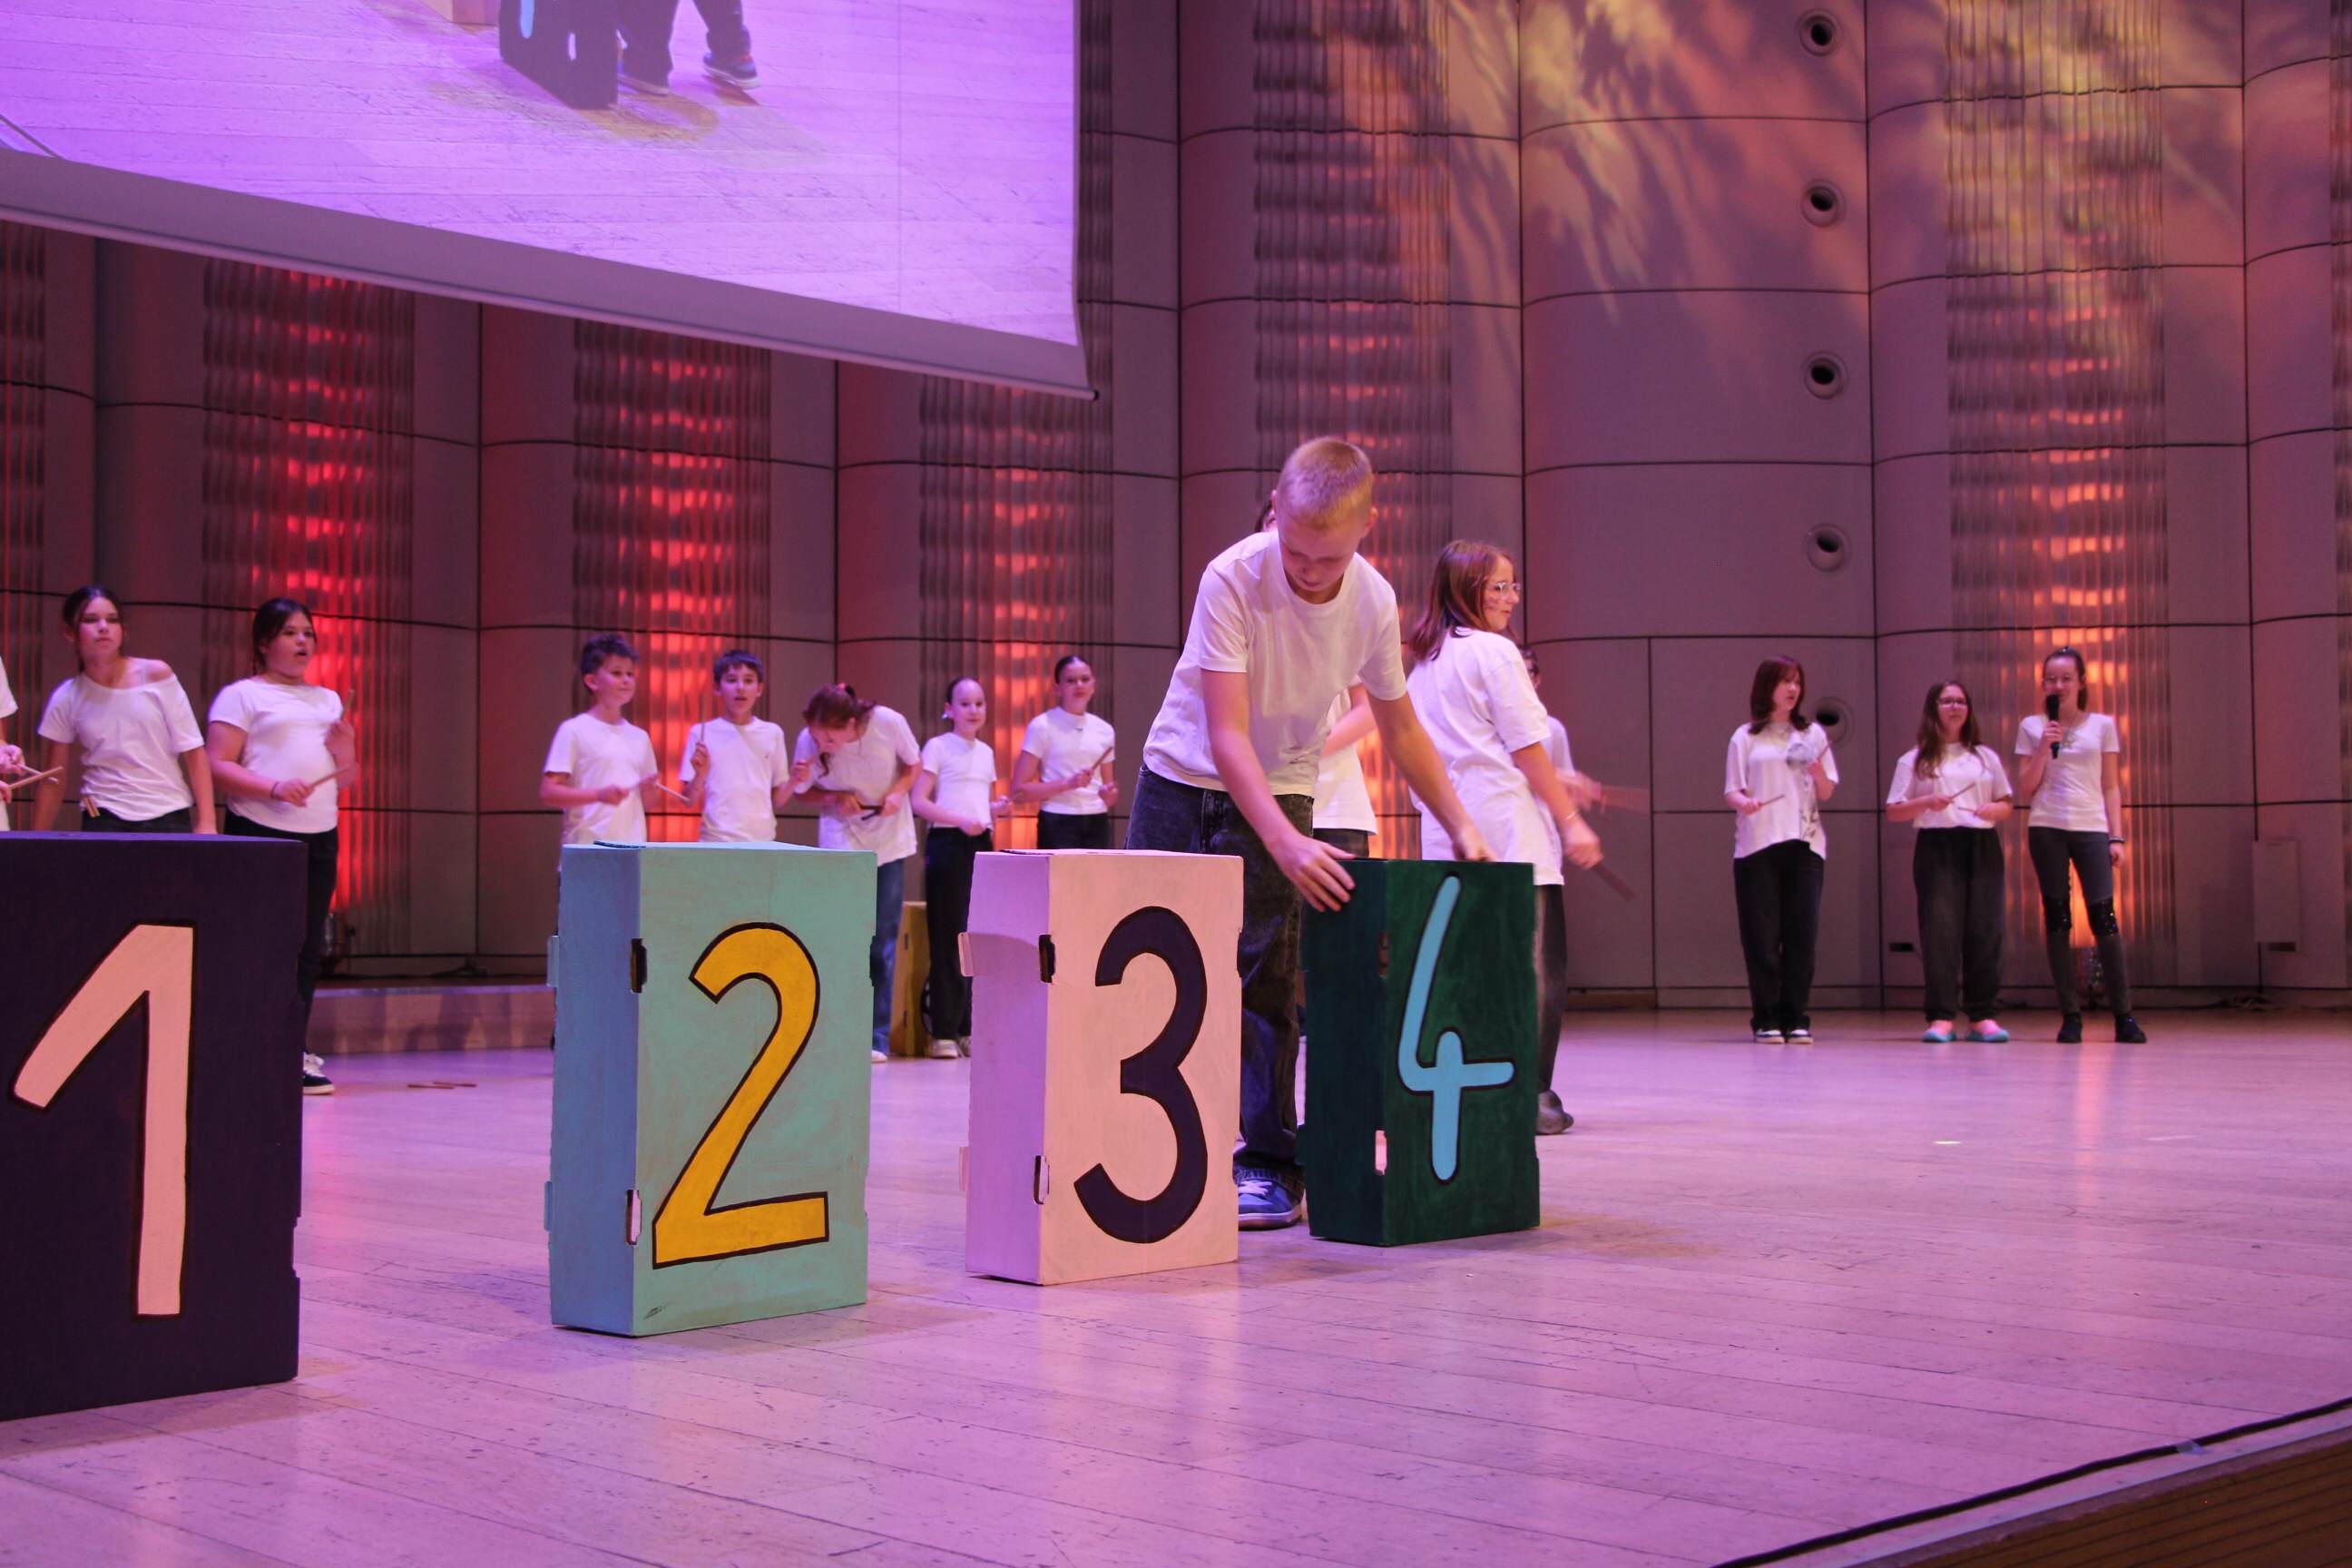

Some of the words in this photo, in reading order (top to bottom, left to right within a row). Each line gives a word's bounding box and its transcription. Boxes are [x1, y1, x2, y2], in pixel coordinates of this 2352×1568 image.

[13, 922, 194, 1318] 1
[652, 922, 828, 1269] 2
[1073, 906, 1208, 1244] 3
[1396, 872, 1515, 1184] 4
